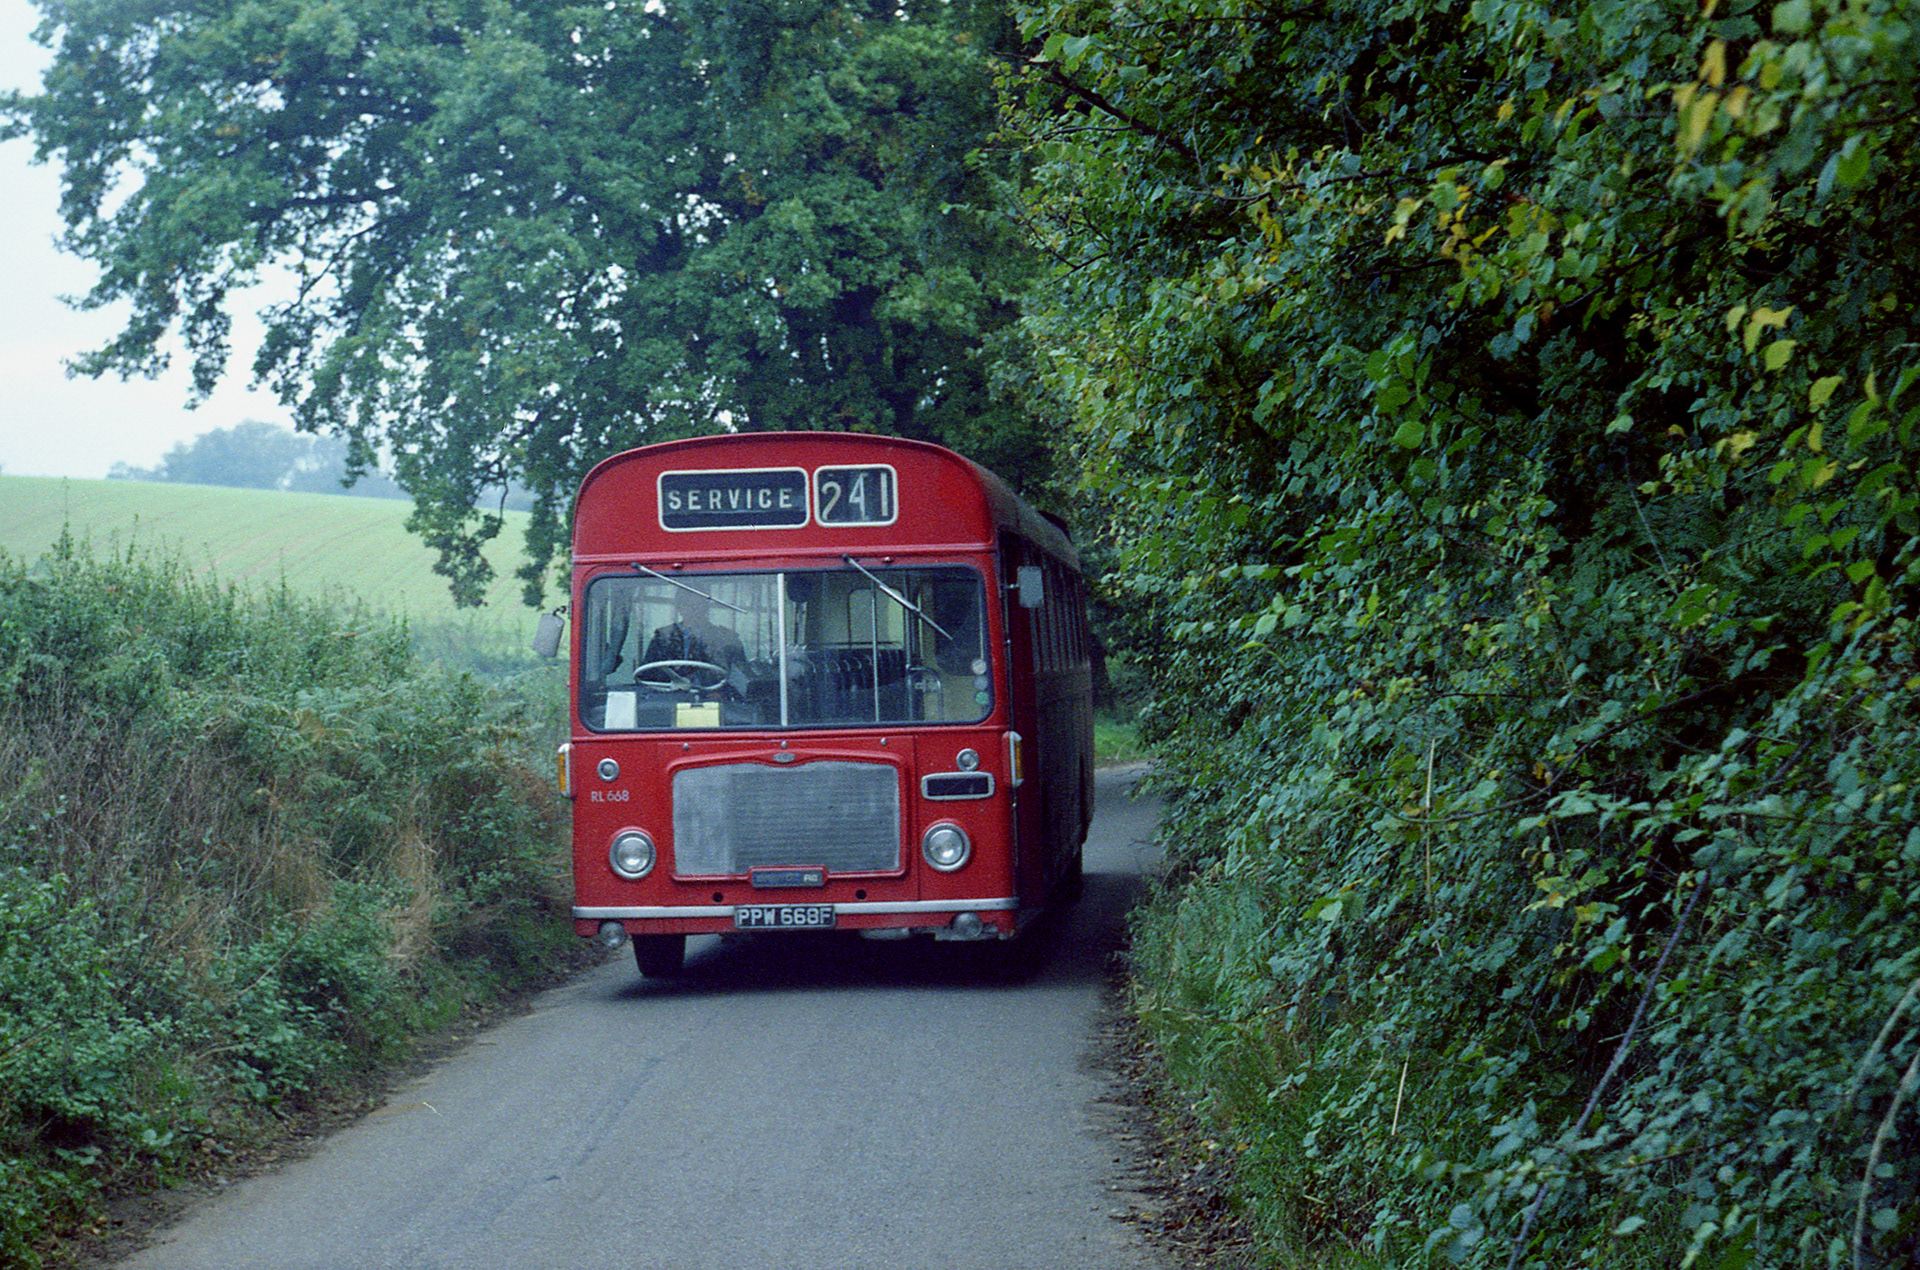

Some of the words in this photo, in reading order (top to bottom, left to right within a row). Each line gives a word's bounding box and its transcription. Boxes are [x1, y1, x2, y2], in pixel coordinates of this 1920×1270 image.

[667, 488, 793, 511] SERVICE
[820, 472, 890, 521] 241
[591, 790, 605, 802] RL
[607, 789, 630, 802] 668
[738, 908, 776, 926] PPW
[780, 907, 833, 925] 668F
